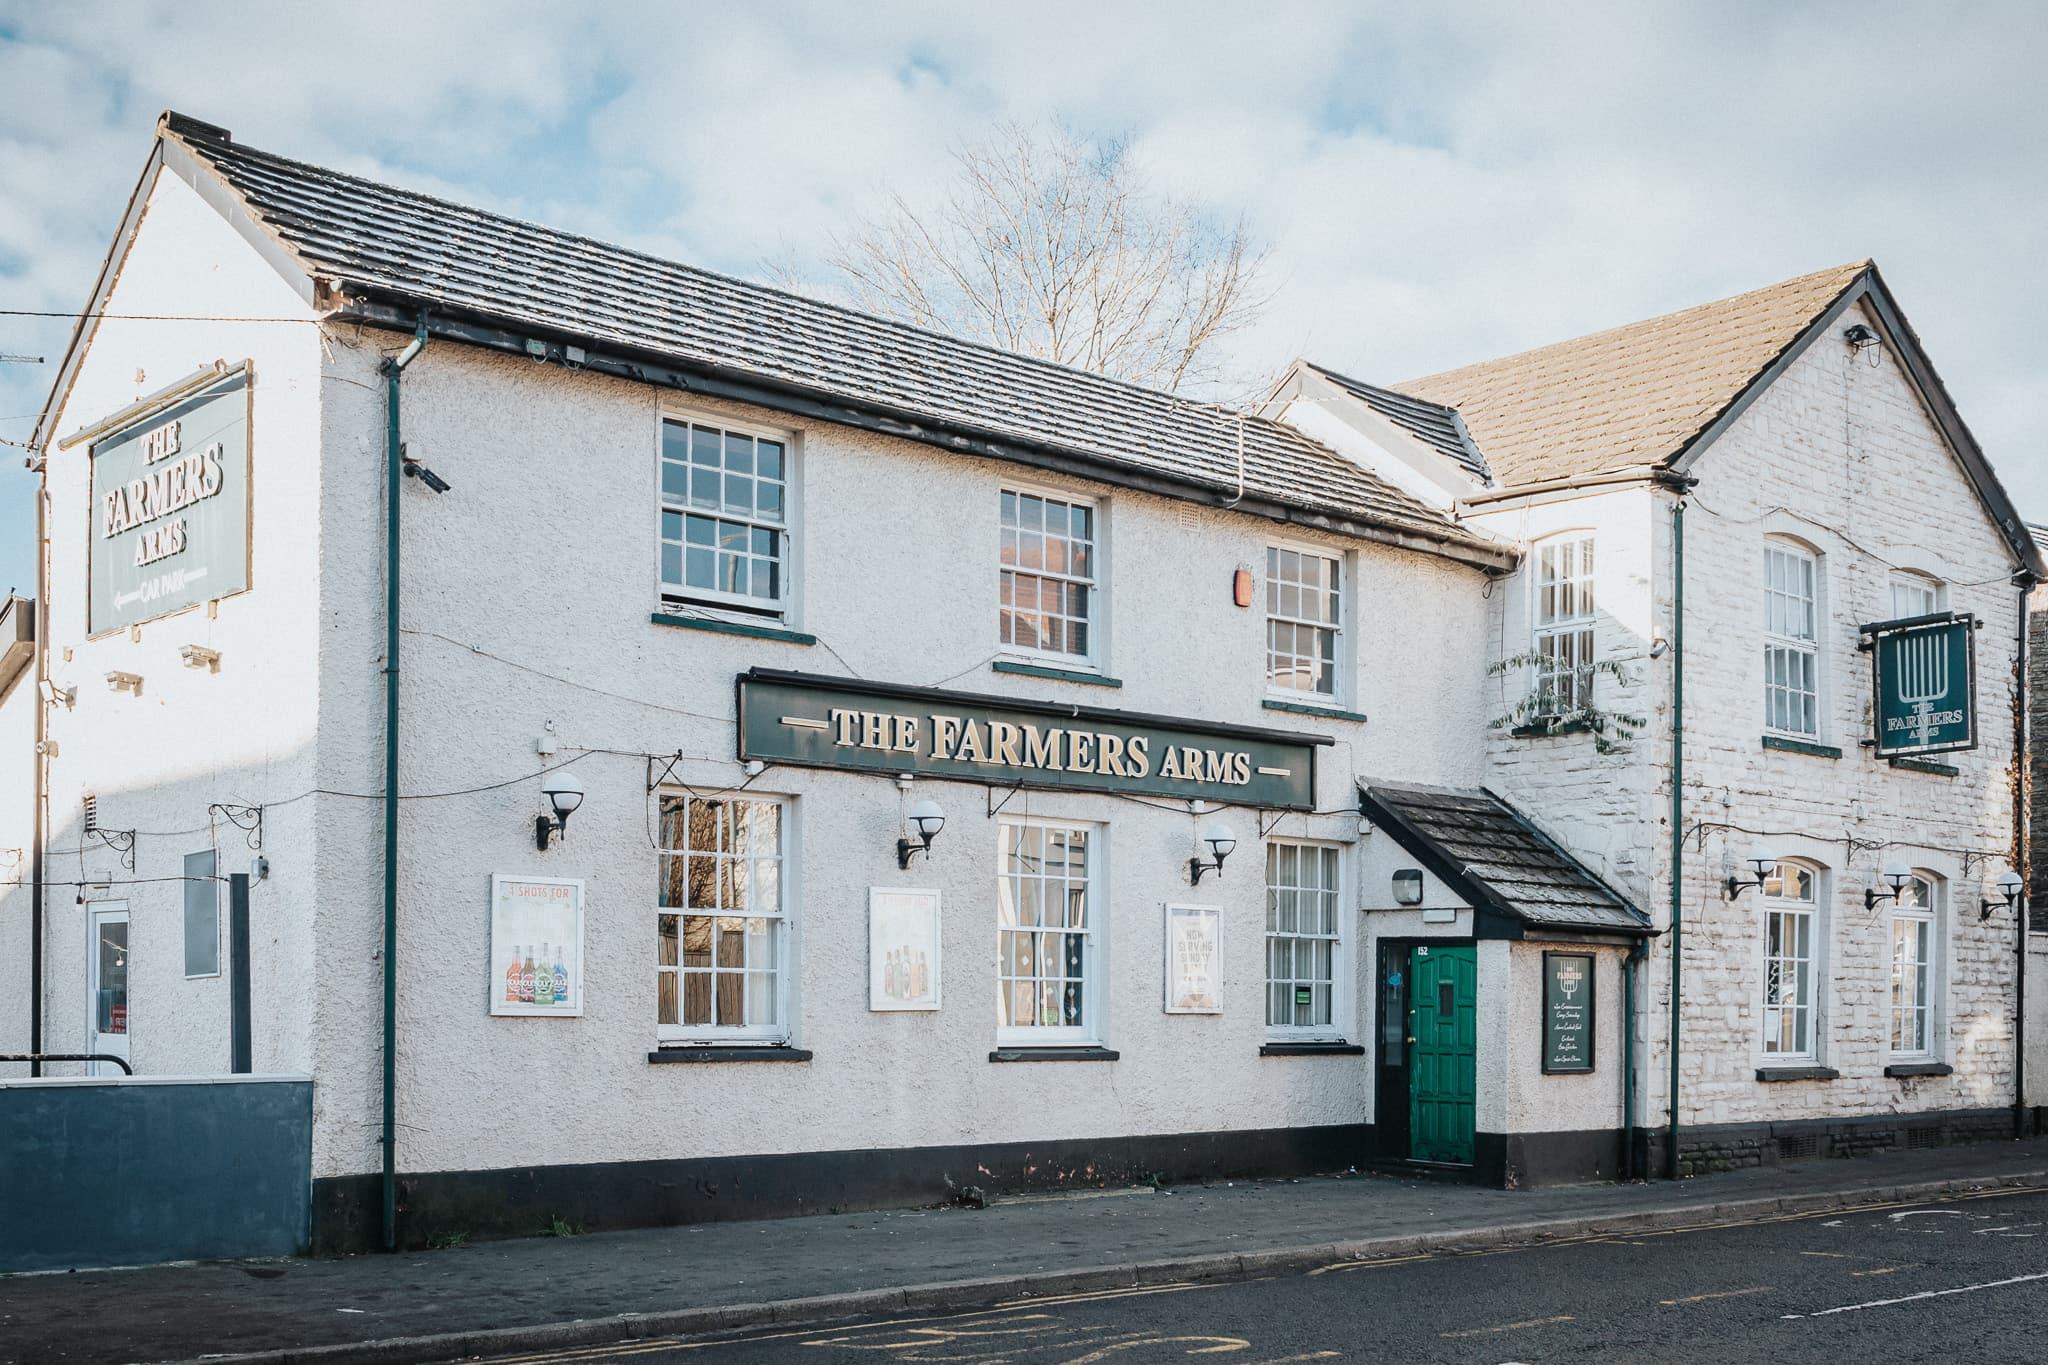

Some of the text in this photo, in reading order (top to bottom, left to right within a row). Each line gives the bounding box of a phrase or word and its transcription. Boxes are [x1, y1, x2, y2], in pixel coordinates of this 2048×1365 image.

[140, 420, 182, 466] THE
[102, 442, 224, 539] FARMERS
[134, 517, 187, 567] ARMS
[139, 568, 186, 603] CAR PARK
[1887, 709, 1964, 731] FARMERS
[1912, 702, 1935, 714] THE
[830, 708, 1251, 785] THE FARMERS ARMS
[518, 886, 547, 898] SHOTS
[551, 887, 570, 899] FOR
[1417, 946, 1429, 956] 152
